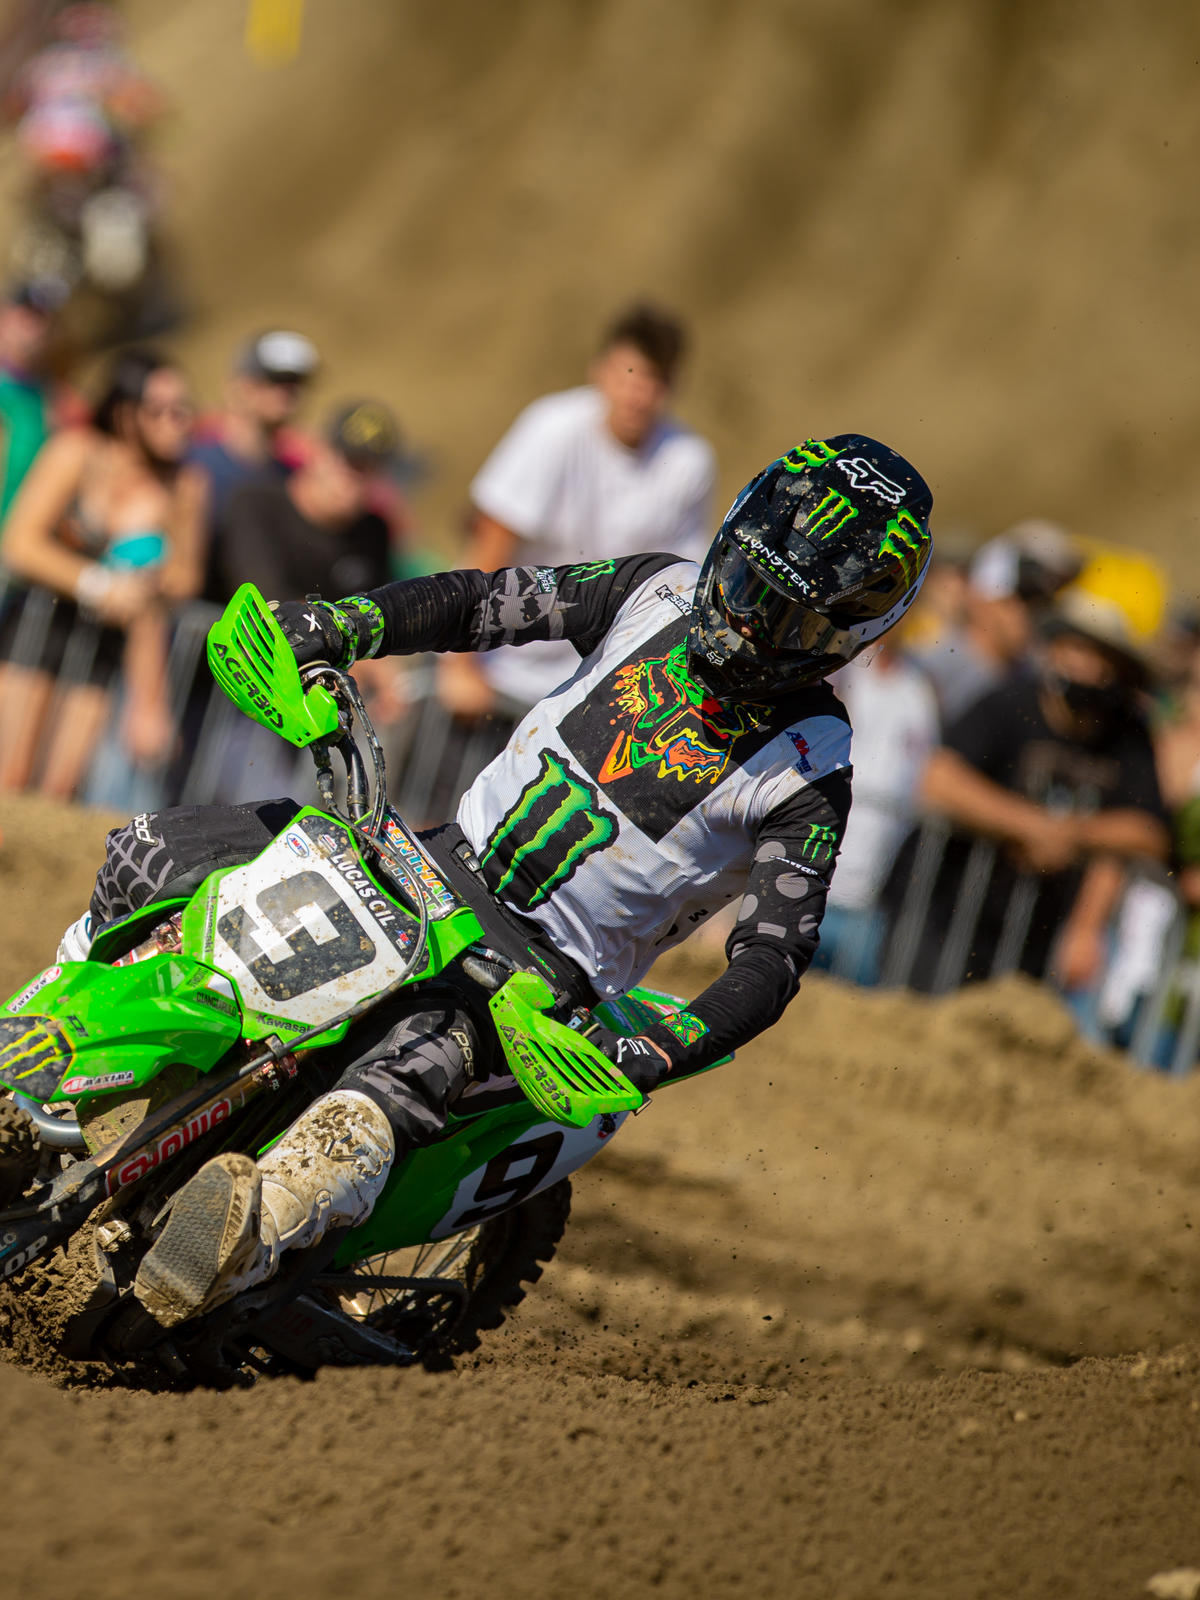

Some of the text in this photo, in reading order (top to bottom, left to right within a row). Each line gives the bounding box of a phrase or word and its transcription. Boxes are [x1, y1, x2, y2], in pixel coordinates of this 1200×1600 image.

[734, 528, 810, 595] MONSTER
[741, 543, 794, 588] ENERGY
[213, 642, 284, 730] ACERBIS
[331, 852, 396, 927] LUCAS OIL
[381, 813, 456, 909] RENTHAL
[256, 1011, 314, 1035] Kawasa
[616, 1036, 651, 1064] FOX
[82, 1070, 134, 1088] MAXIMA
[499, 1023, 572, 1116] ACERBIS
[451, 1130, 566, 1229] 9
